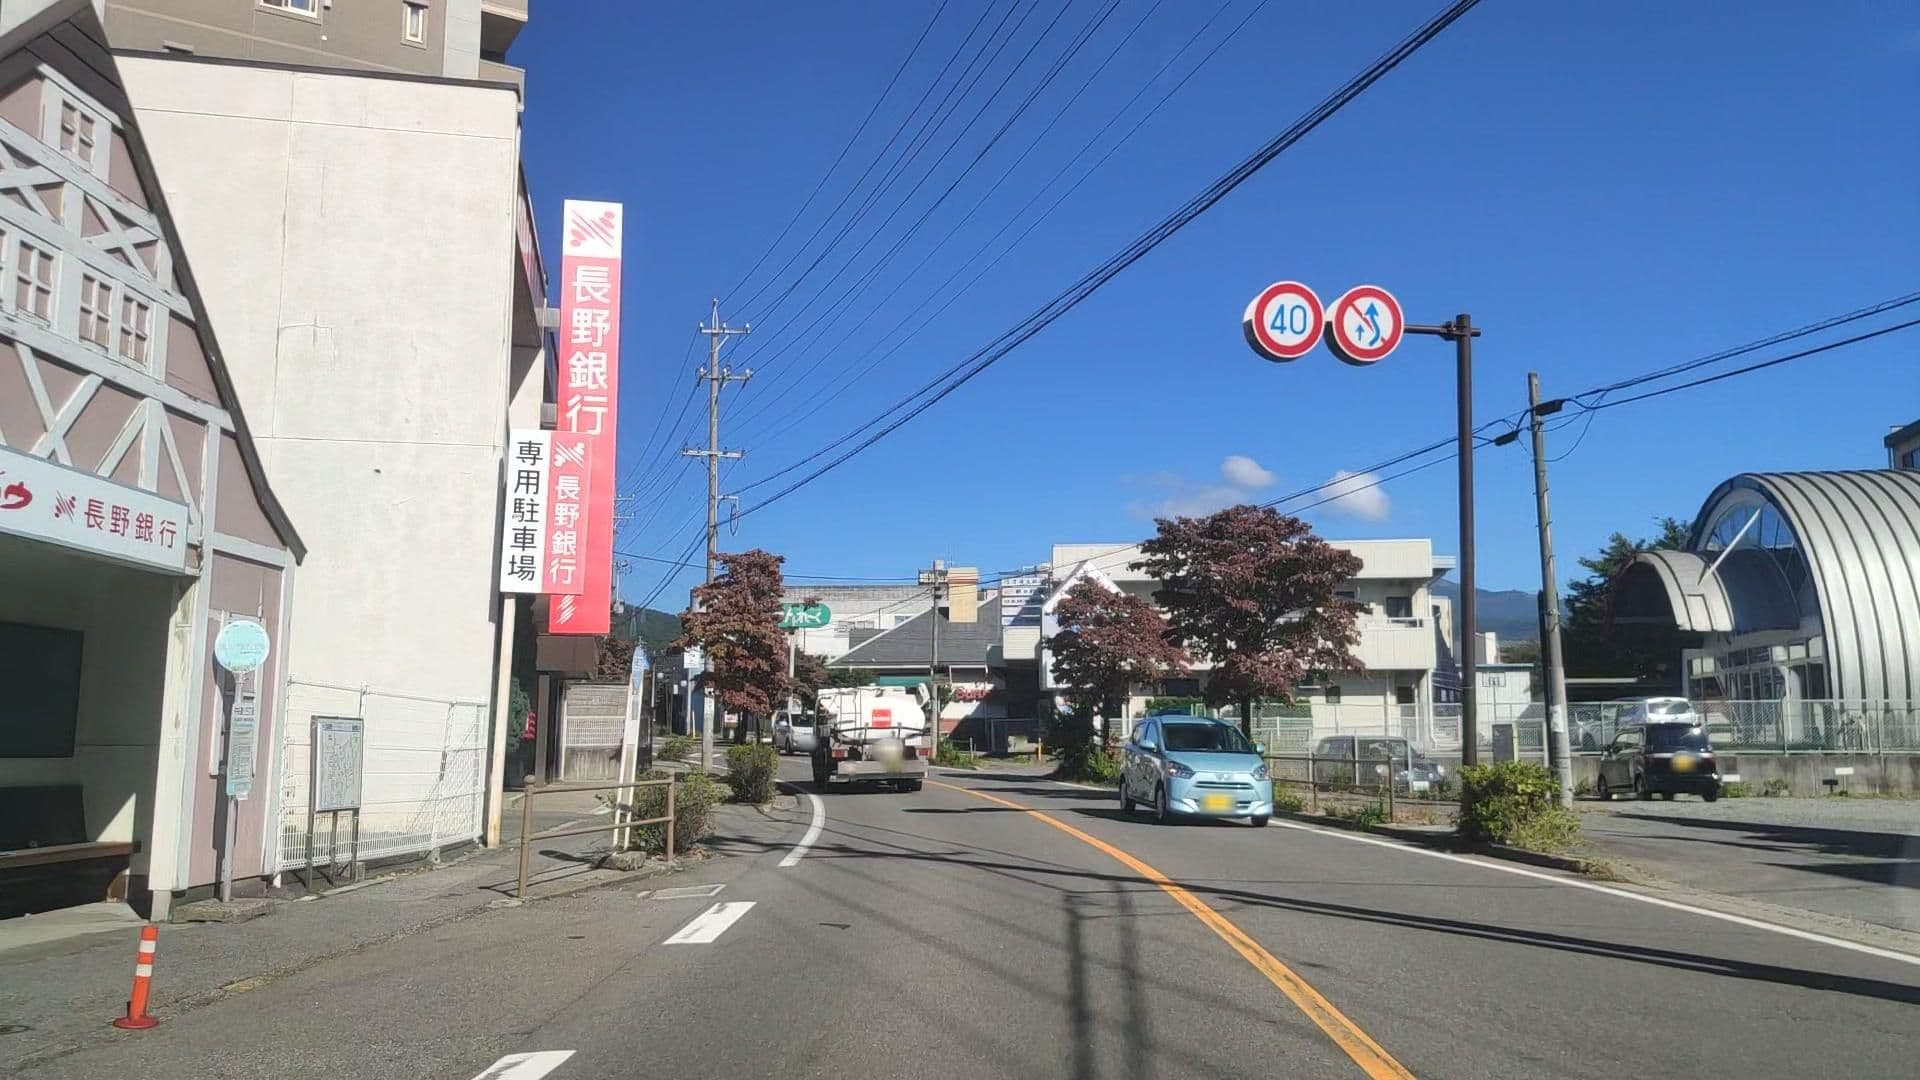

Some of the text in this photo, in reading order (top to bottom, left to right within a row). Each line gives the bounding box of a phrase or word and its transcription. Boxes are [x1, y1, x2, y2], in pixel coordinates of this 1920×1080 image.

[565, 265, 612, 436] 長野銀行
[1270, 303, 1307, 335] 40
[83, 497, 177, 549] 長野銀行
[507, 440, 543, 582] 専用駐車場
[549, 475, 581, 585] 長野銀行
